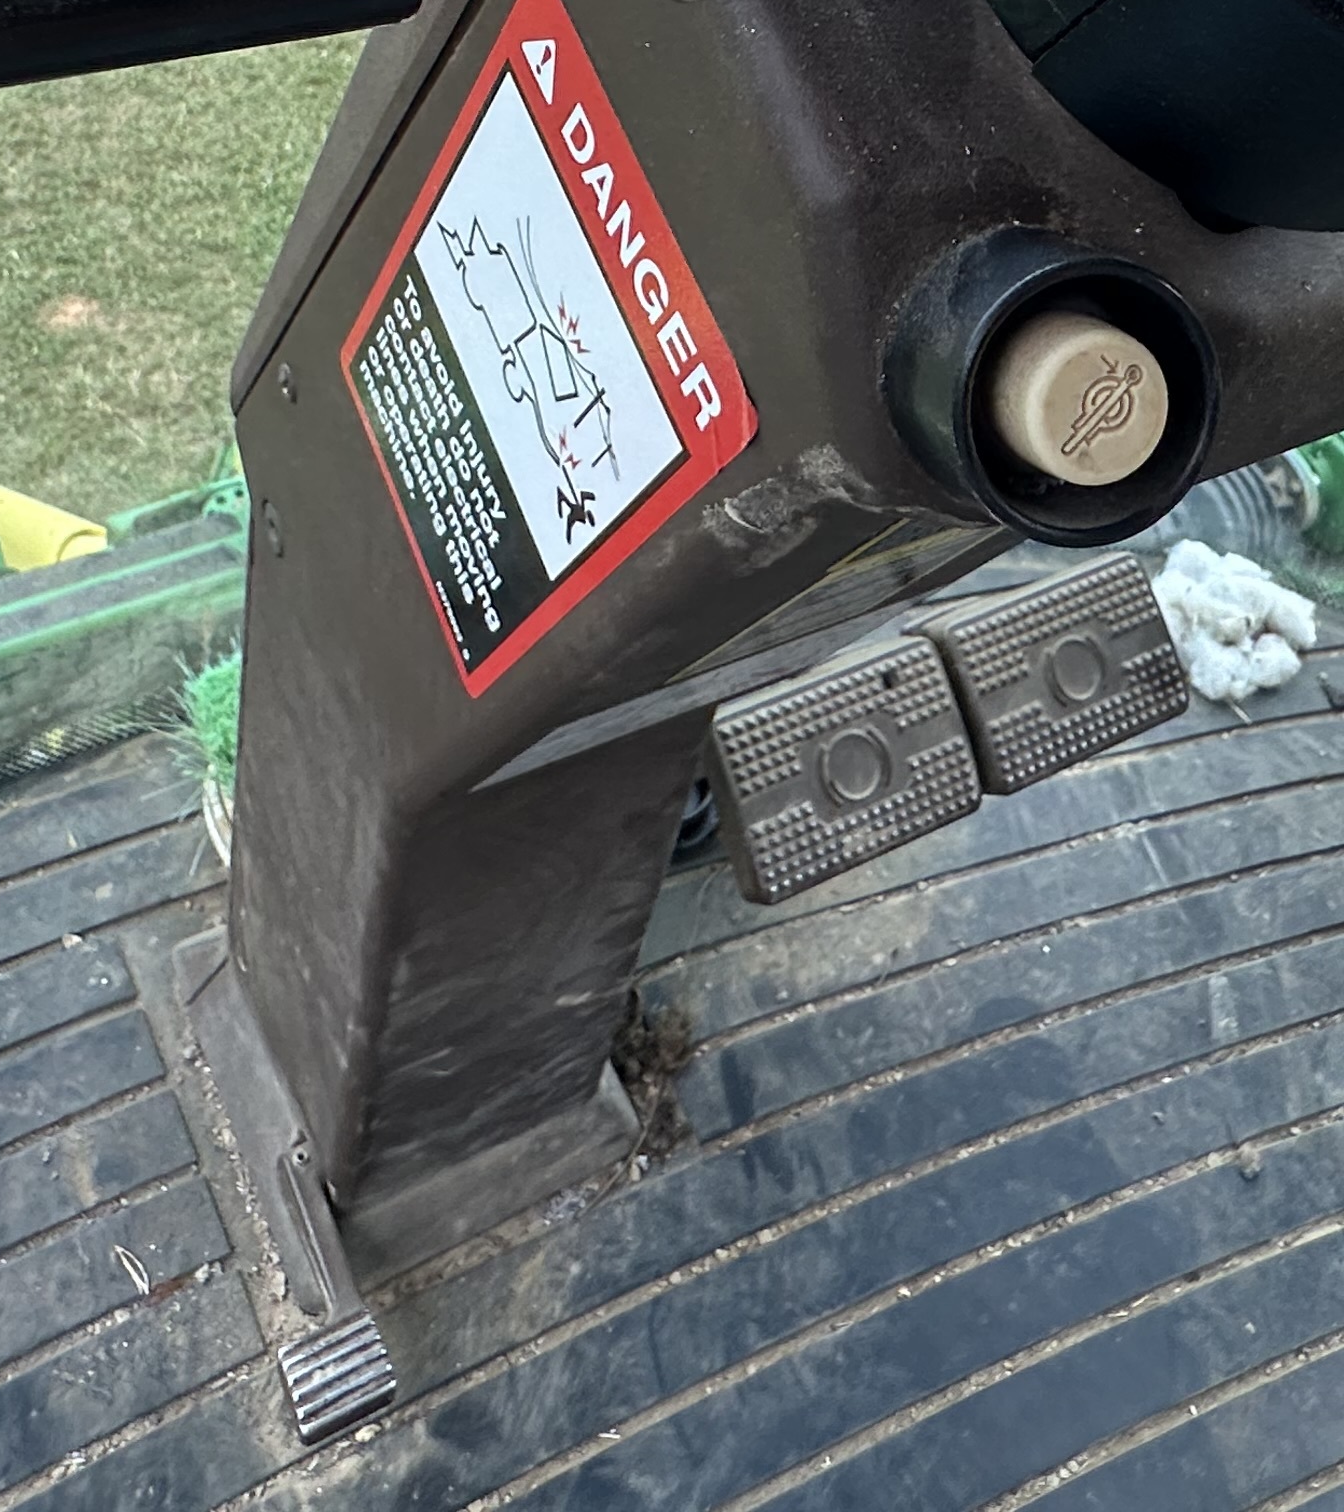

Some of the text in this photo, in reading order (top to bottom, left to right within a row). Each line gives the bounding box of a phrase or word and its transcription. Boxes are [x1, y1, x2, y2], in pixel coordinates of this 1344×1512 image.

[403, 274, 507, 519] To avoid injury
[560, 102, 722, 431] DANGER
[359, 359, 416, 500] machine.
[367, 345, 386, 377] or
[383, 384, 447, 537] operating
[445, 539, 475, 605] this
[375, 326, 409, 406] lines
[408, 407, 447, 499] when
[445, 503, 501, 633] moving
[384, 314, 437, 434] contact
[434, 437, 502, 591] electrical
[393, 297, 500, 549] or death do not
